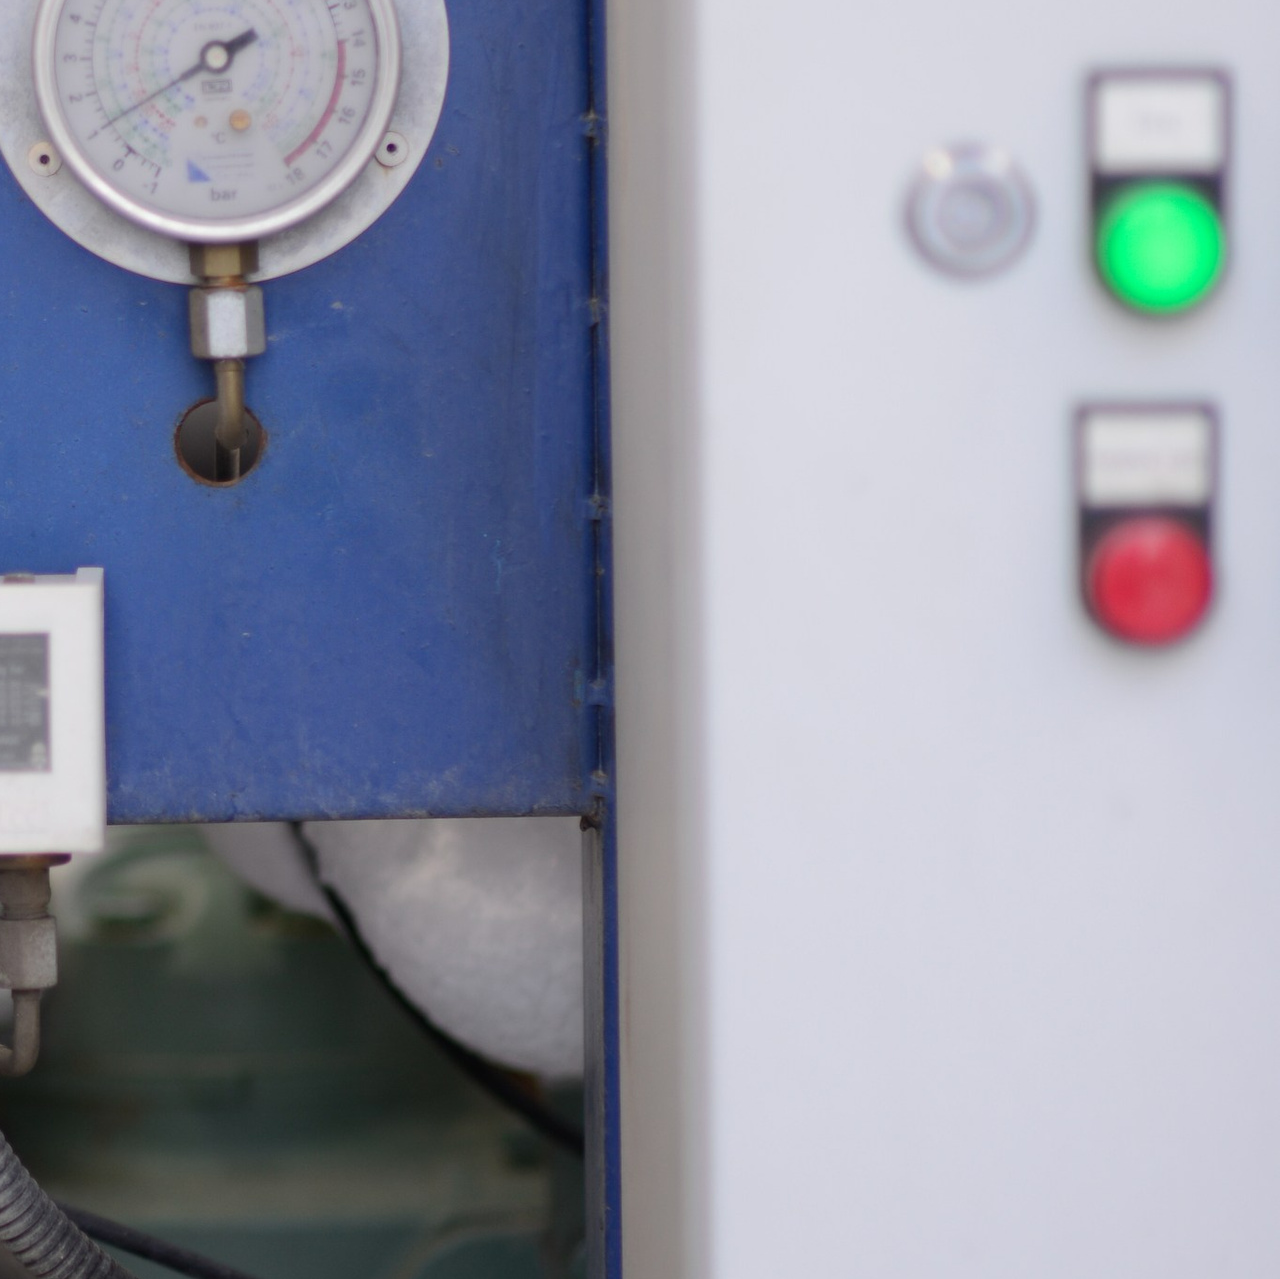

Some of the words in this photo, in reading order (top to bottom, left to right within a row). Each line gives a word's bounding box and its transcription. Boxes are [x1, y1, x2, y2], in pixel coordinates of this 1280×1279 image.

[69, 13, 82, 25] 4
[352, 28, 367, 48] 14
[63, 53, 78, 64] 3
[350, 68, 366, 86] 15
[69, 94, 83, 104] 2
[338, 106, 356, 124] 16
[315, 140, 334, 159] 17
[113, 158, 125, 172] 0
[284, 166, 305, 185] 18
[210, 188, 237, 202] bar
